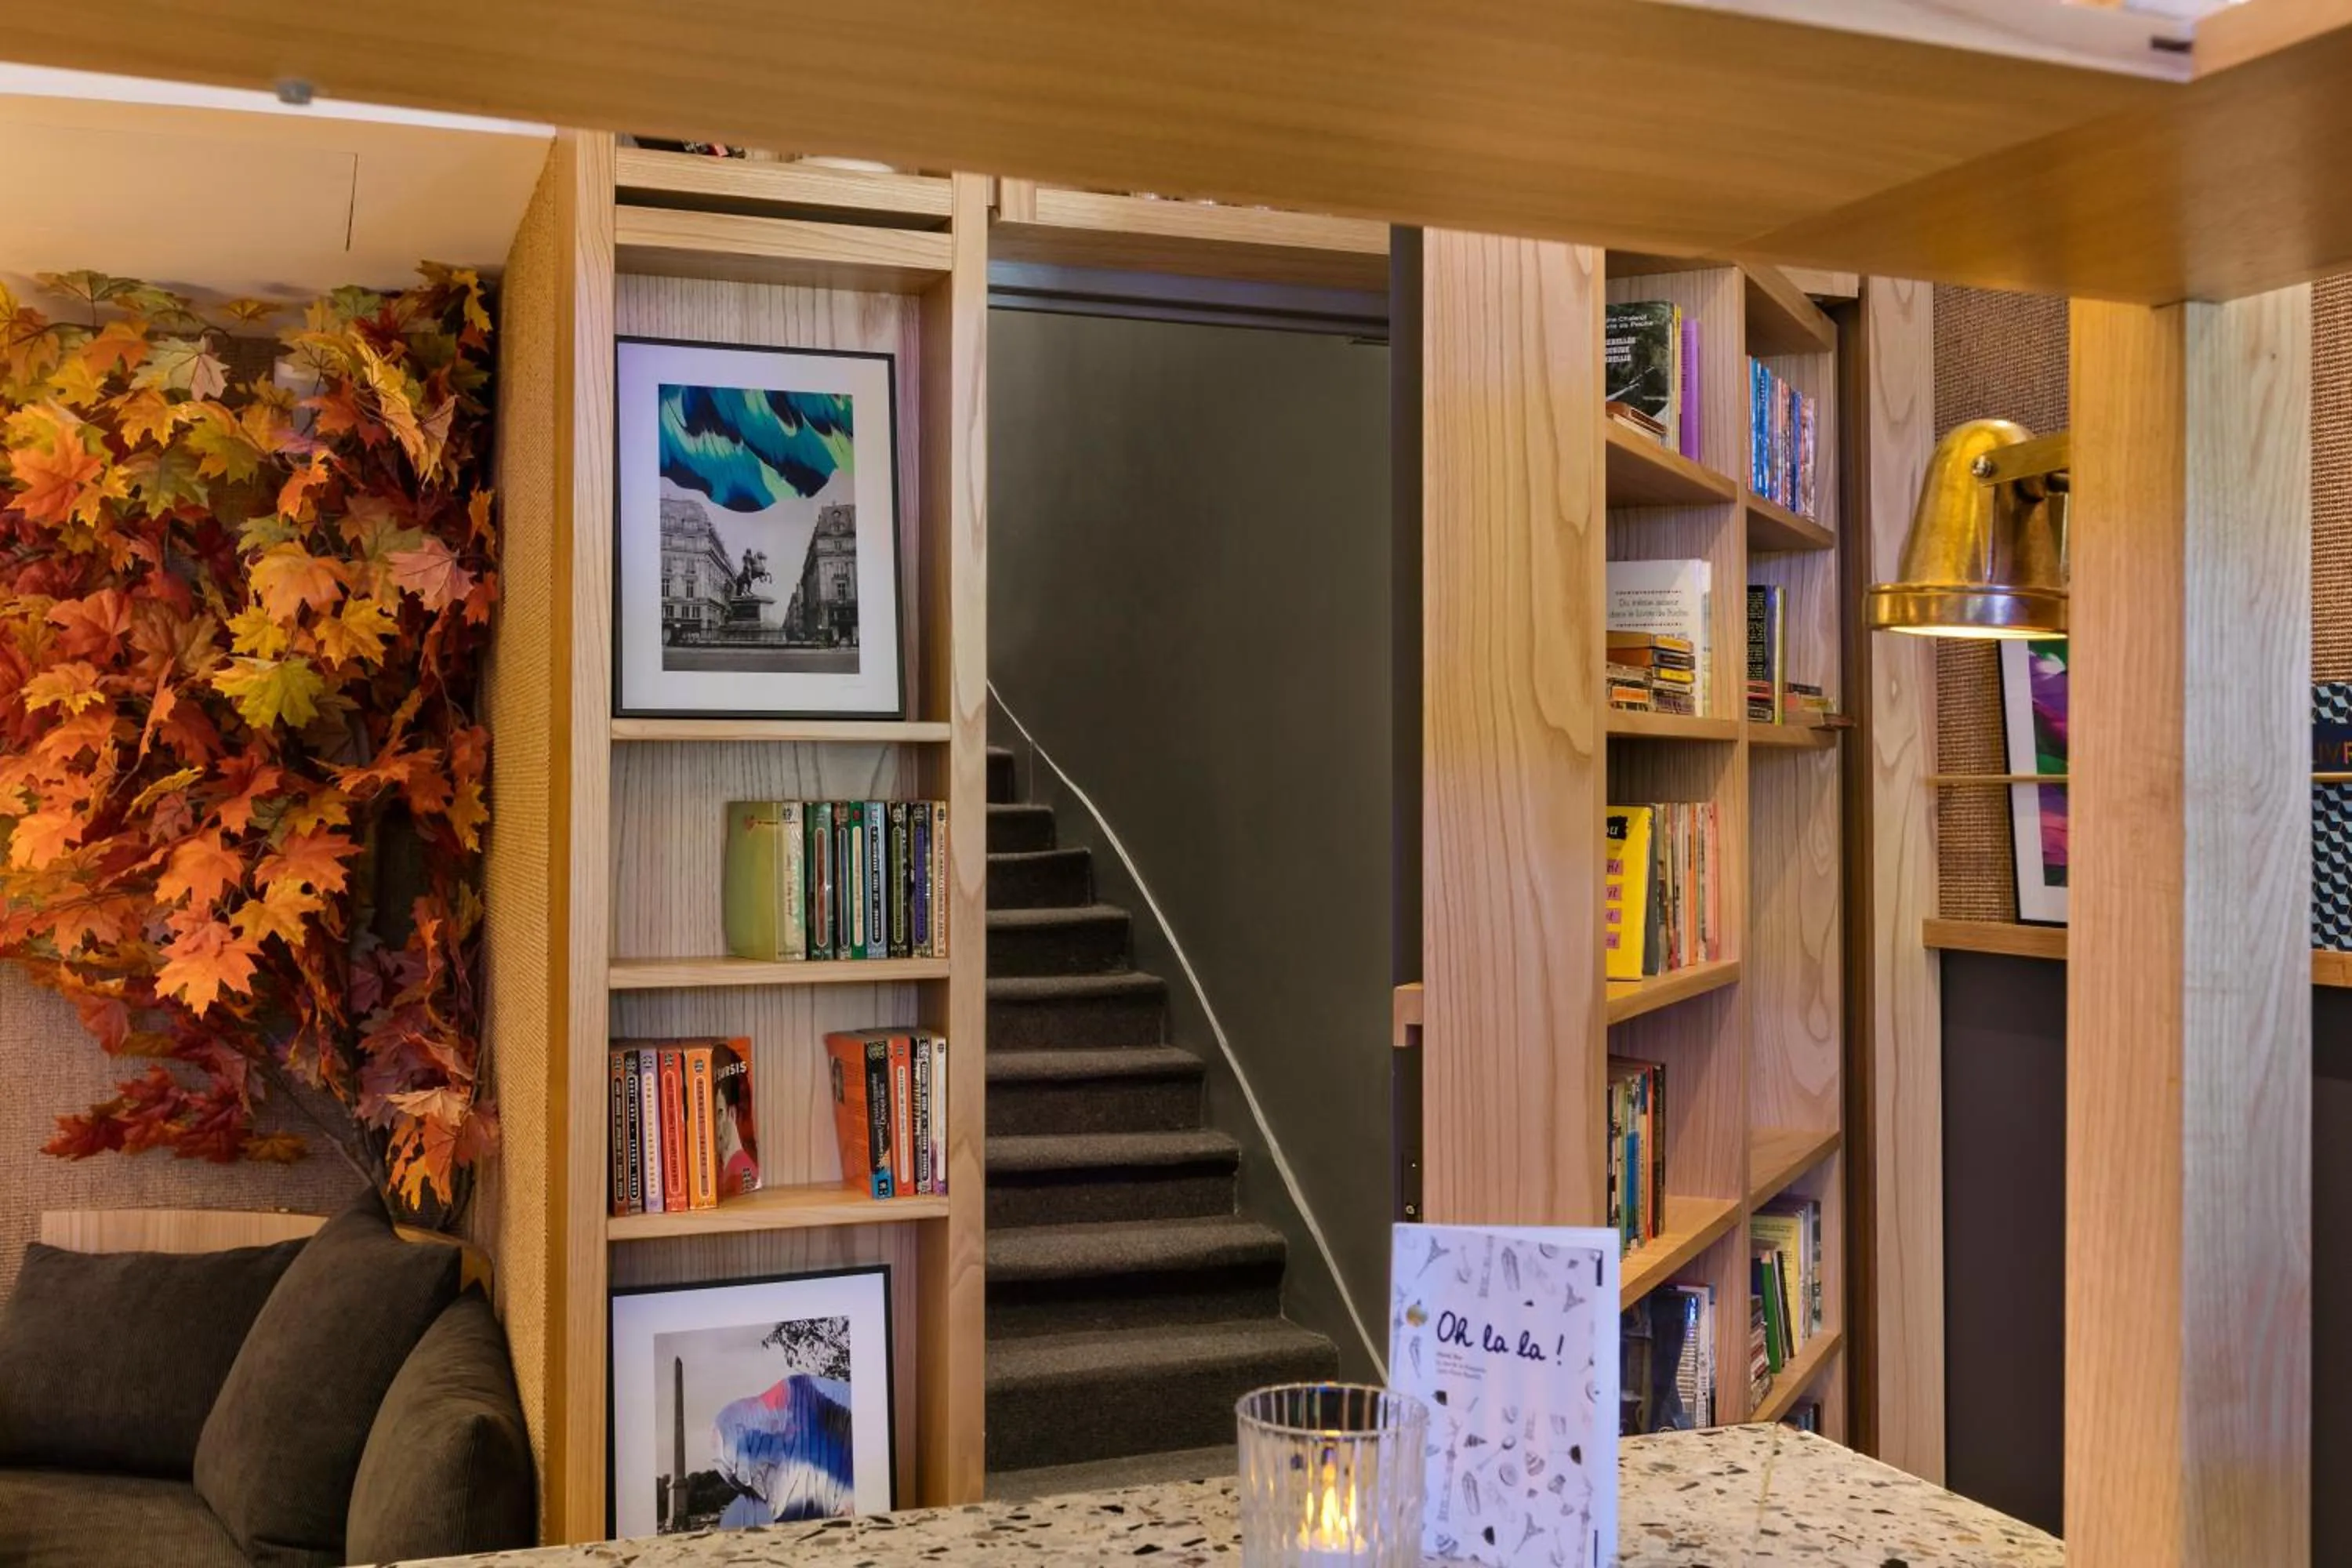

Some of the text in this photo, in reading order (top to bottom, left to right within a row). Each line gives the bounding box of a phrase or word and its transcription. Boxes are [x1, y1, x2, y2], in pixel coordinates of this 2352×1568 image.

[1437, 1310, 1564, 1366] Oh la la !
